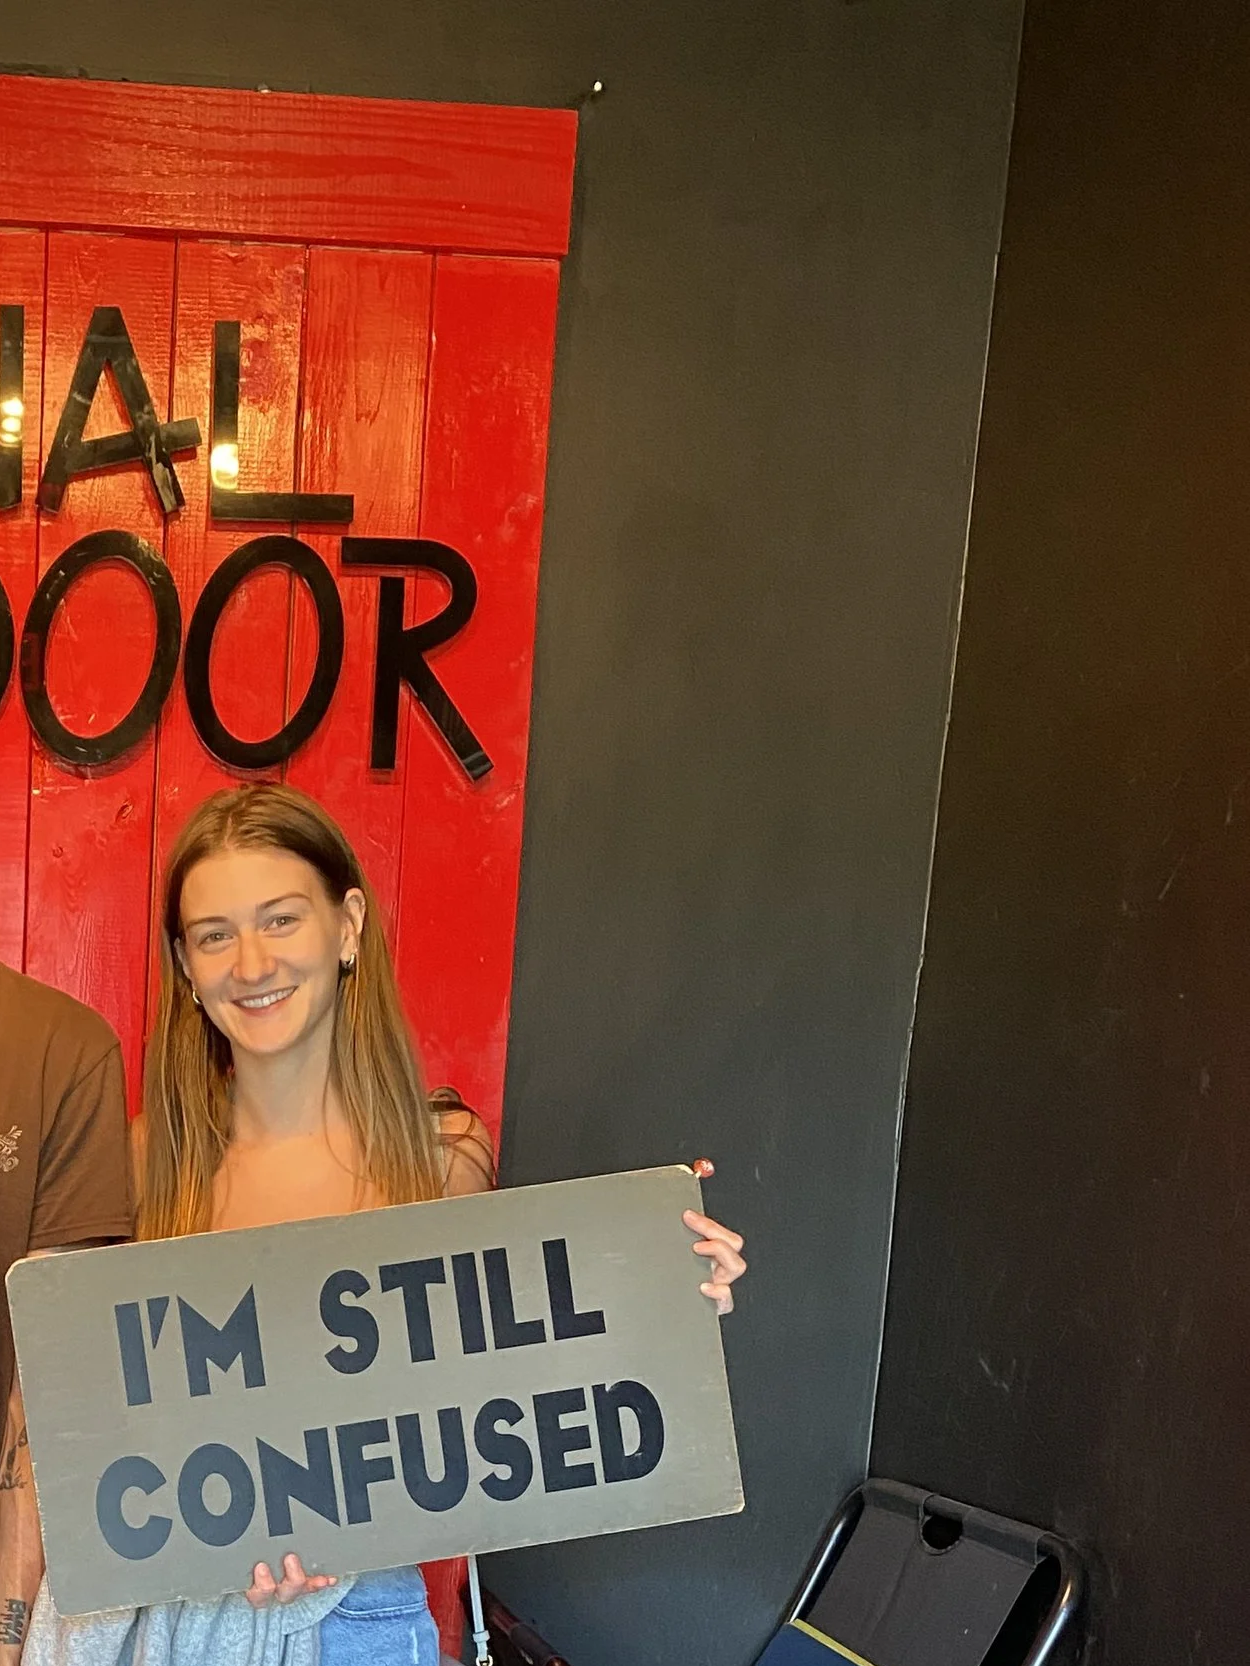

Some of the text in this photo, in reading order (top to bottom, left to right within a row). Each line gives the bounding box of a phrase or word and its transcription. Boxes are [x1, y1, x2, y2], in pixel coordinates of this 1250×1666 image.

[114, 1237, 607, 1406] I'M STILL
[96, 1379, 666, 1562] CONFUSED
